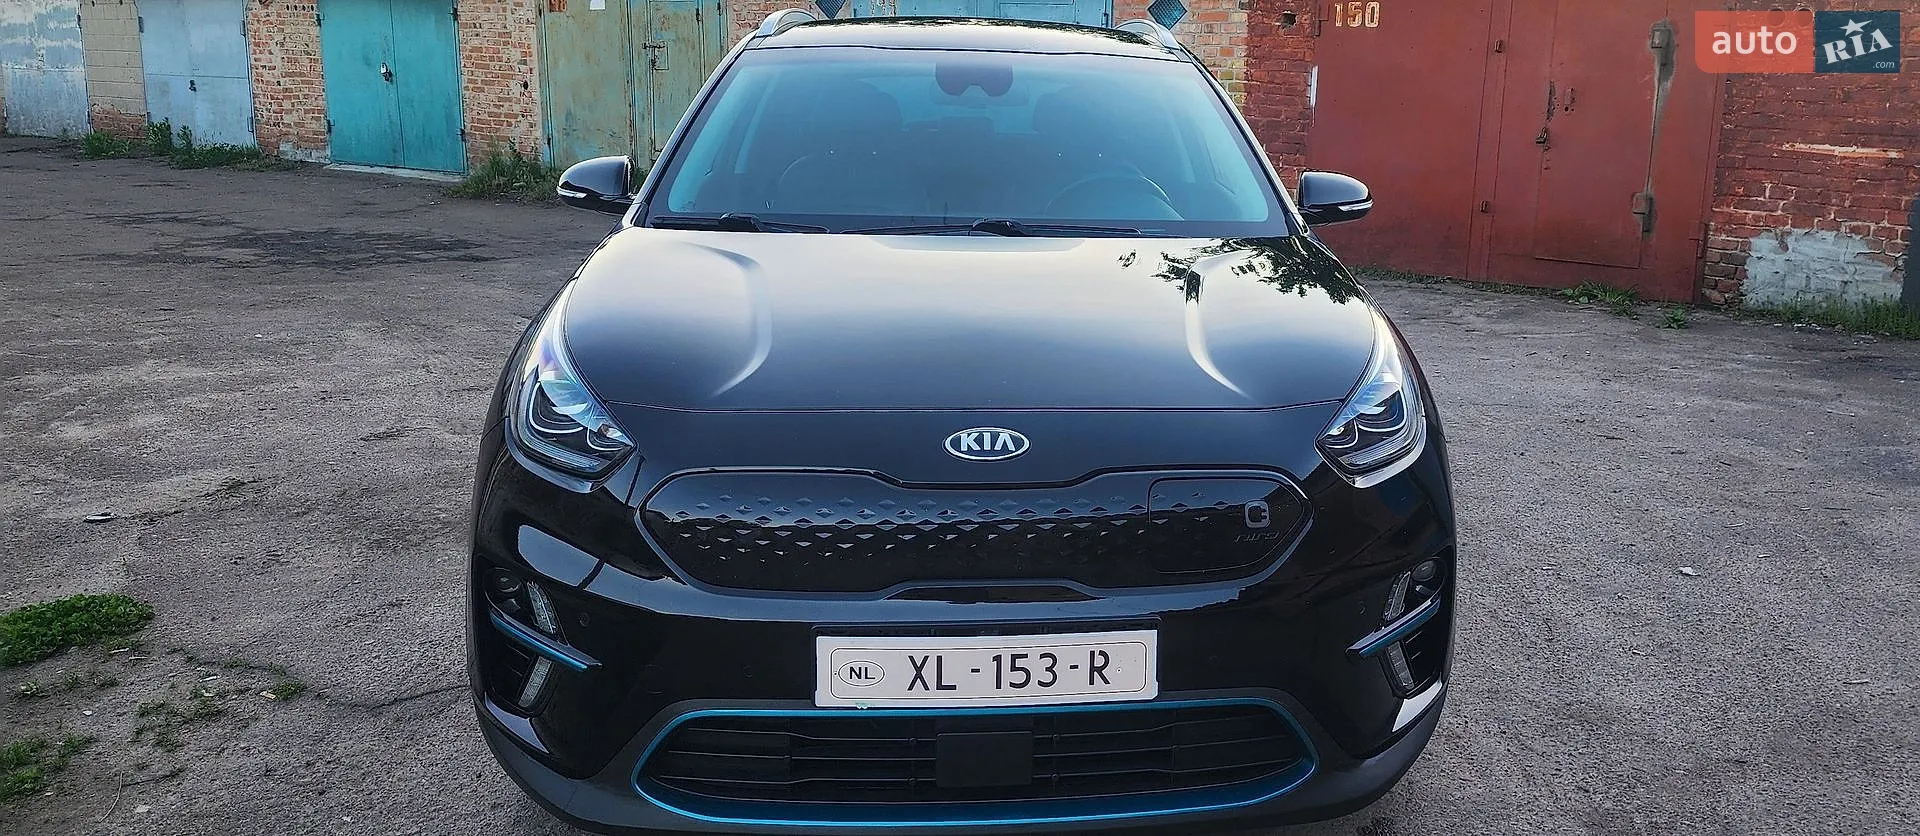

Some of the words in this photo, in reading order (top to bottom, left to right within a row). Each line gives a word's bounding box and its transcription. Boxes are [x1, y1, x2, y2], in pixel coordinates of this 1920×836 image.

[1335, 1, 1380, 28] 150
[960, 432, 1016, 452] KIA
[849, 666, 876, 681] NL
